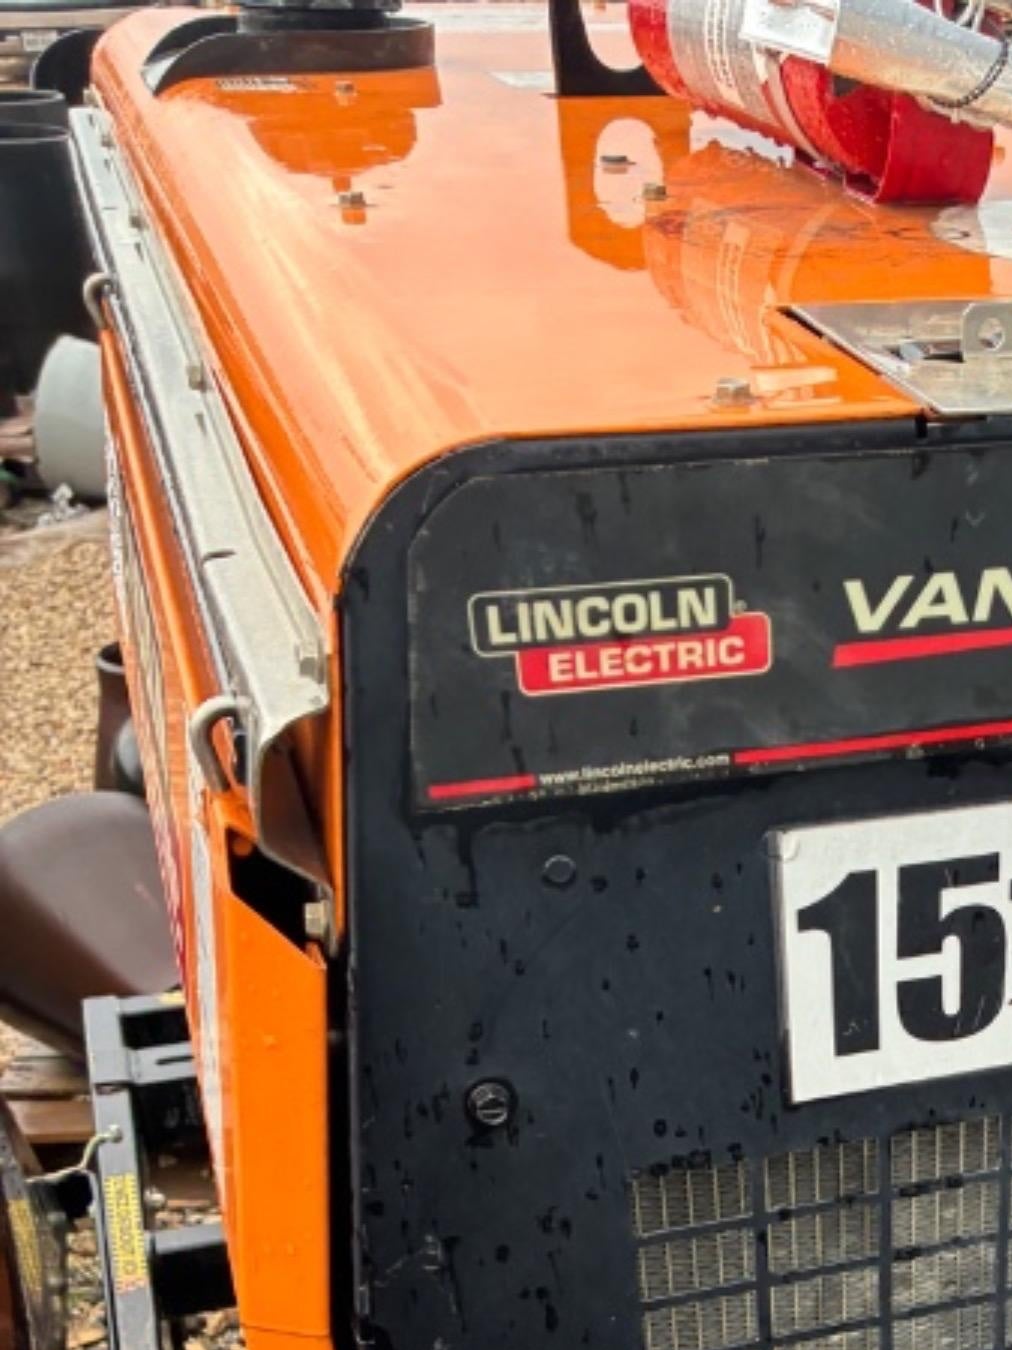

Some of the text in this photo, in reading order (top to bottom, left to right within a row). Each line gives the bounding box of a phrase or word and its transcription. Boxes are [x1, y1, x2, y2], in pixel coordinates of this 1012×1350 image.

[486, 586, 718, 646] LINCOLN
[548, 636, 746, 683] ELECTRIC
[538, 754, 731, 786] www.lincolnelectric.com
